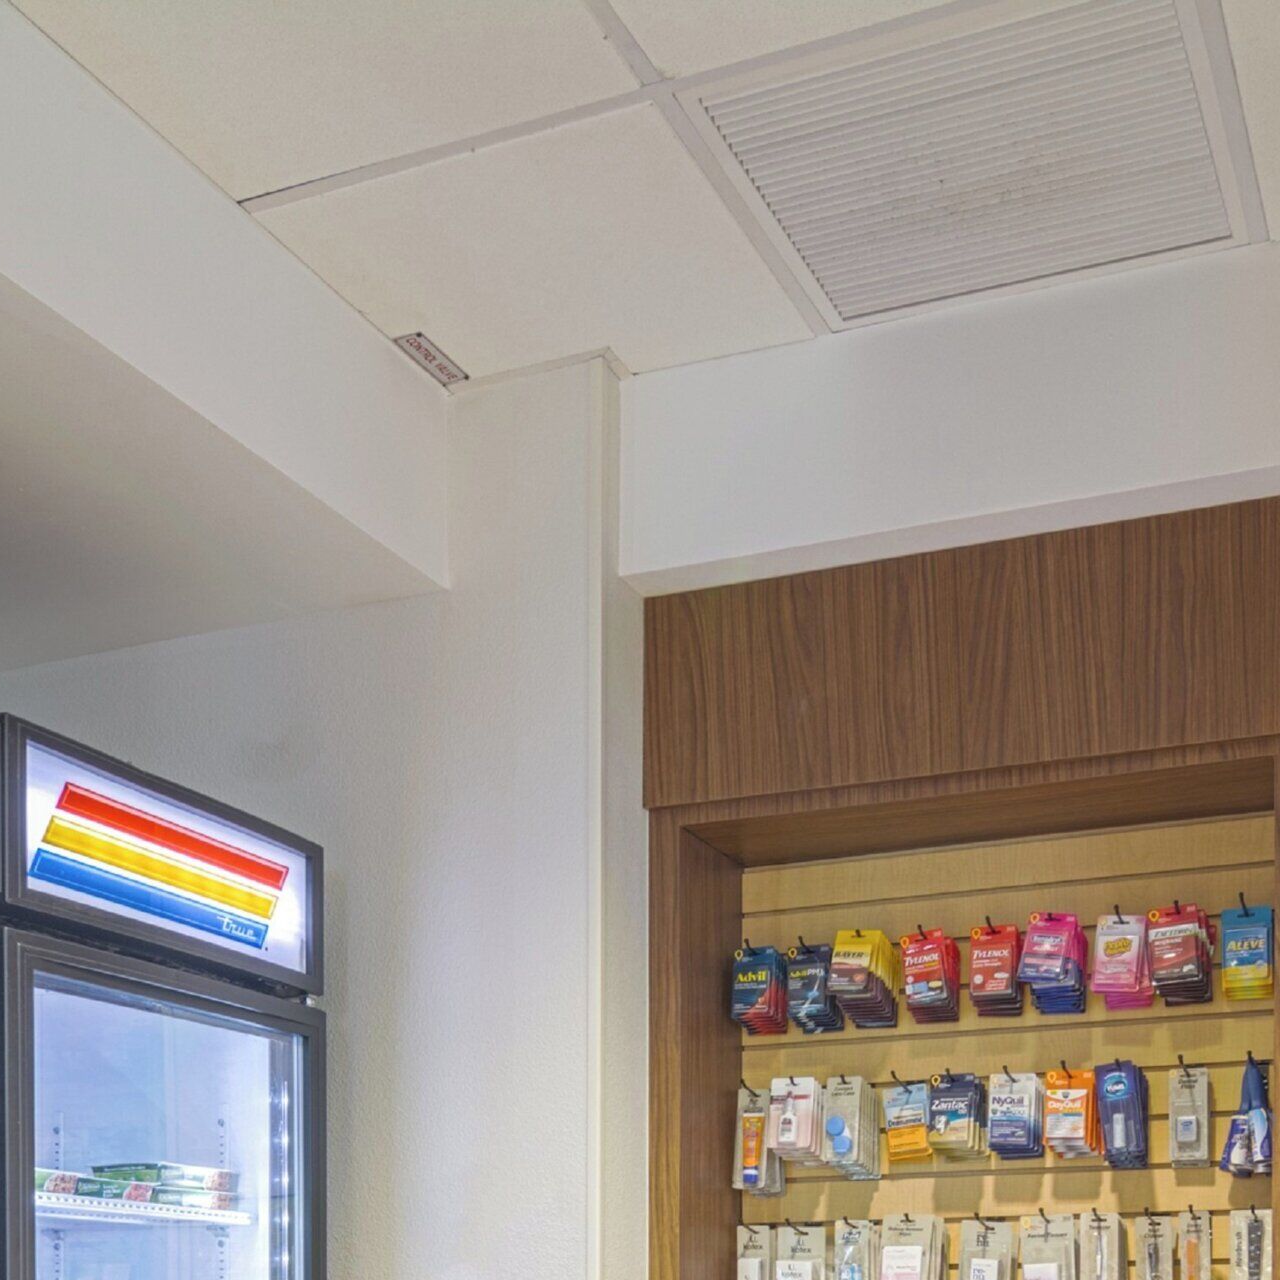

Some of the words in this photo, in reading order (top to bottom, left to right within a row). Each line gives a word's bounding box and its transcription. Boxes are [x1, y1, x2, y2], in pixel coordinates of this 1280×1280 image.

[1226, 938, 1265, 951] ALEVE
[904, 953, 940, 967] TYLENOL
[972, 948, 1010, 960] TYLENOL
[736, 970, 767, 983] Advil
[931, 1099, 969, 1111] Zantac
[992, 1094, 1025, 1106] NyQuil
